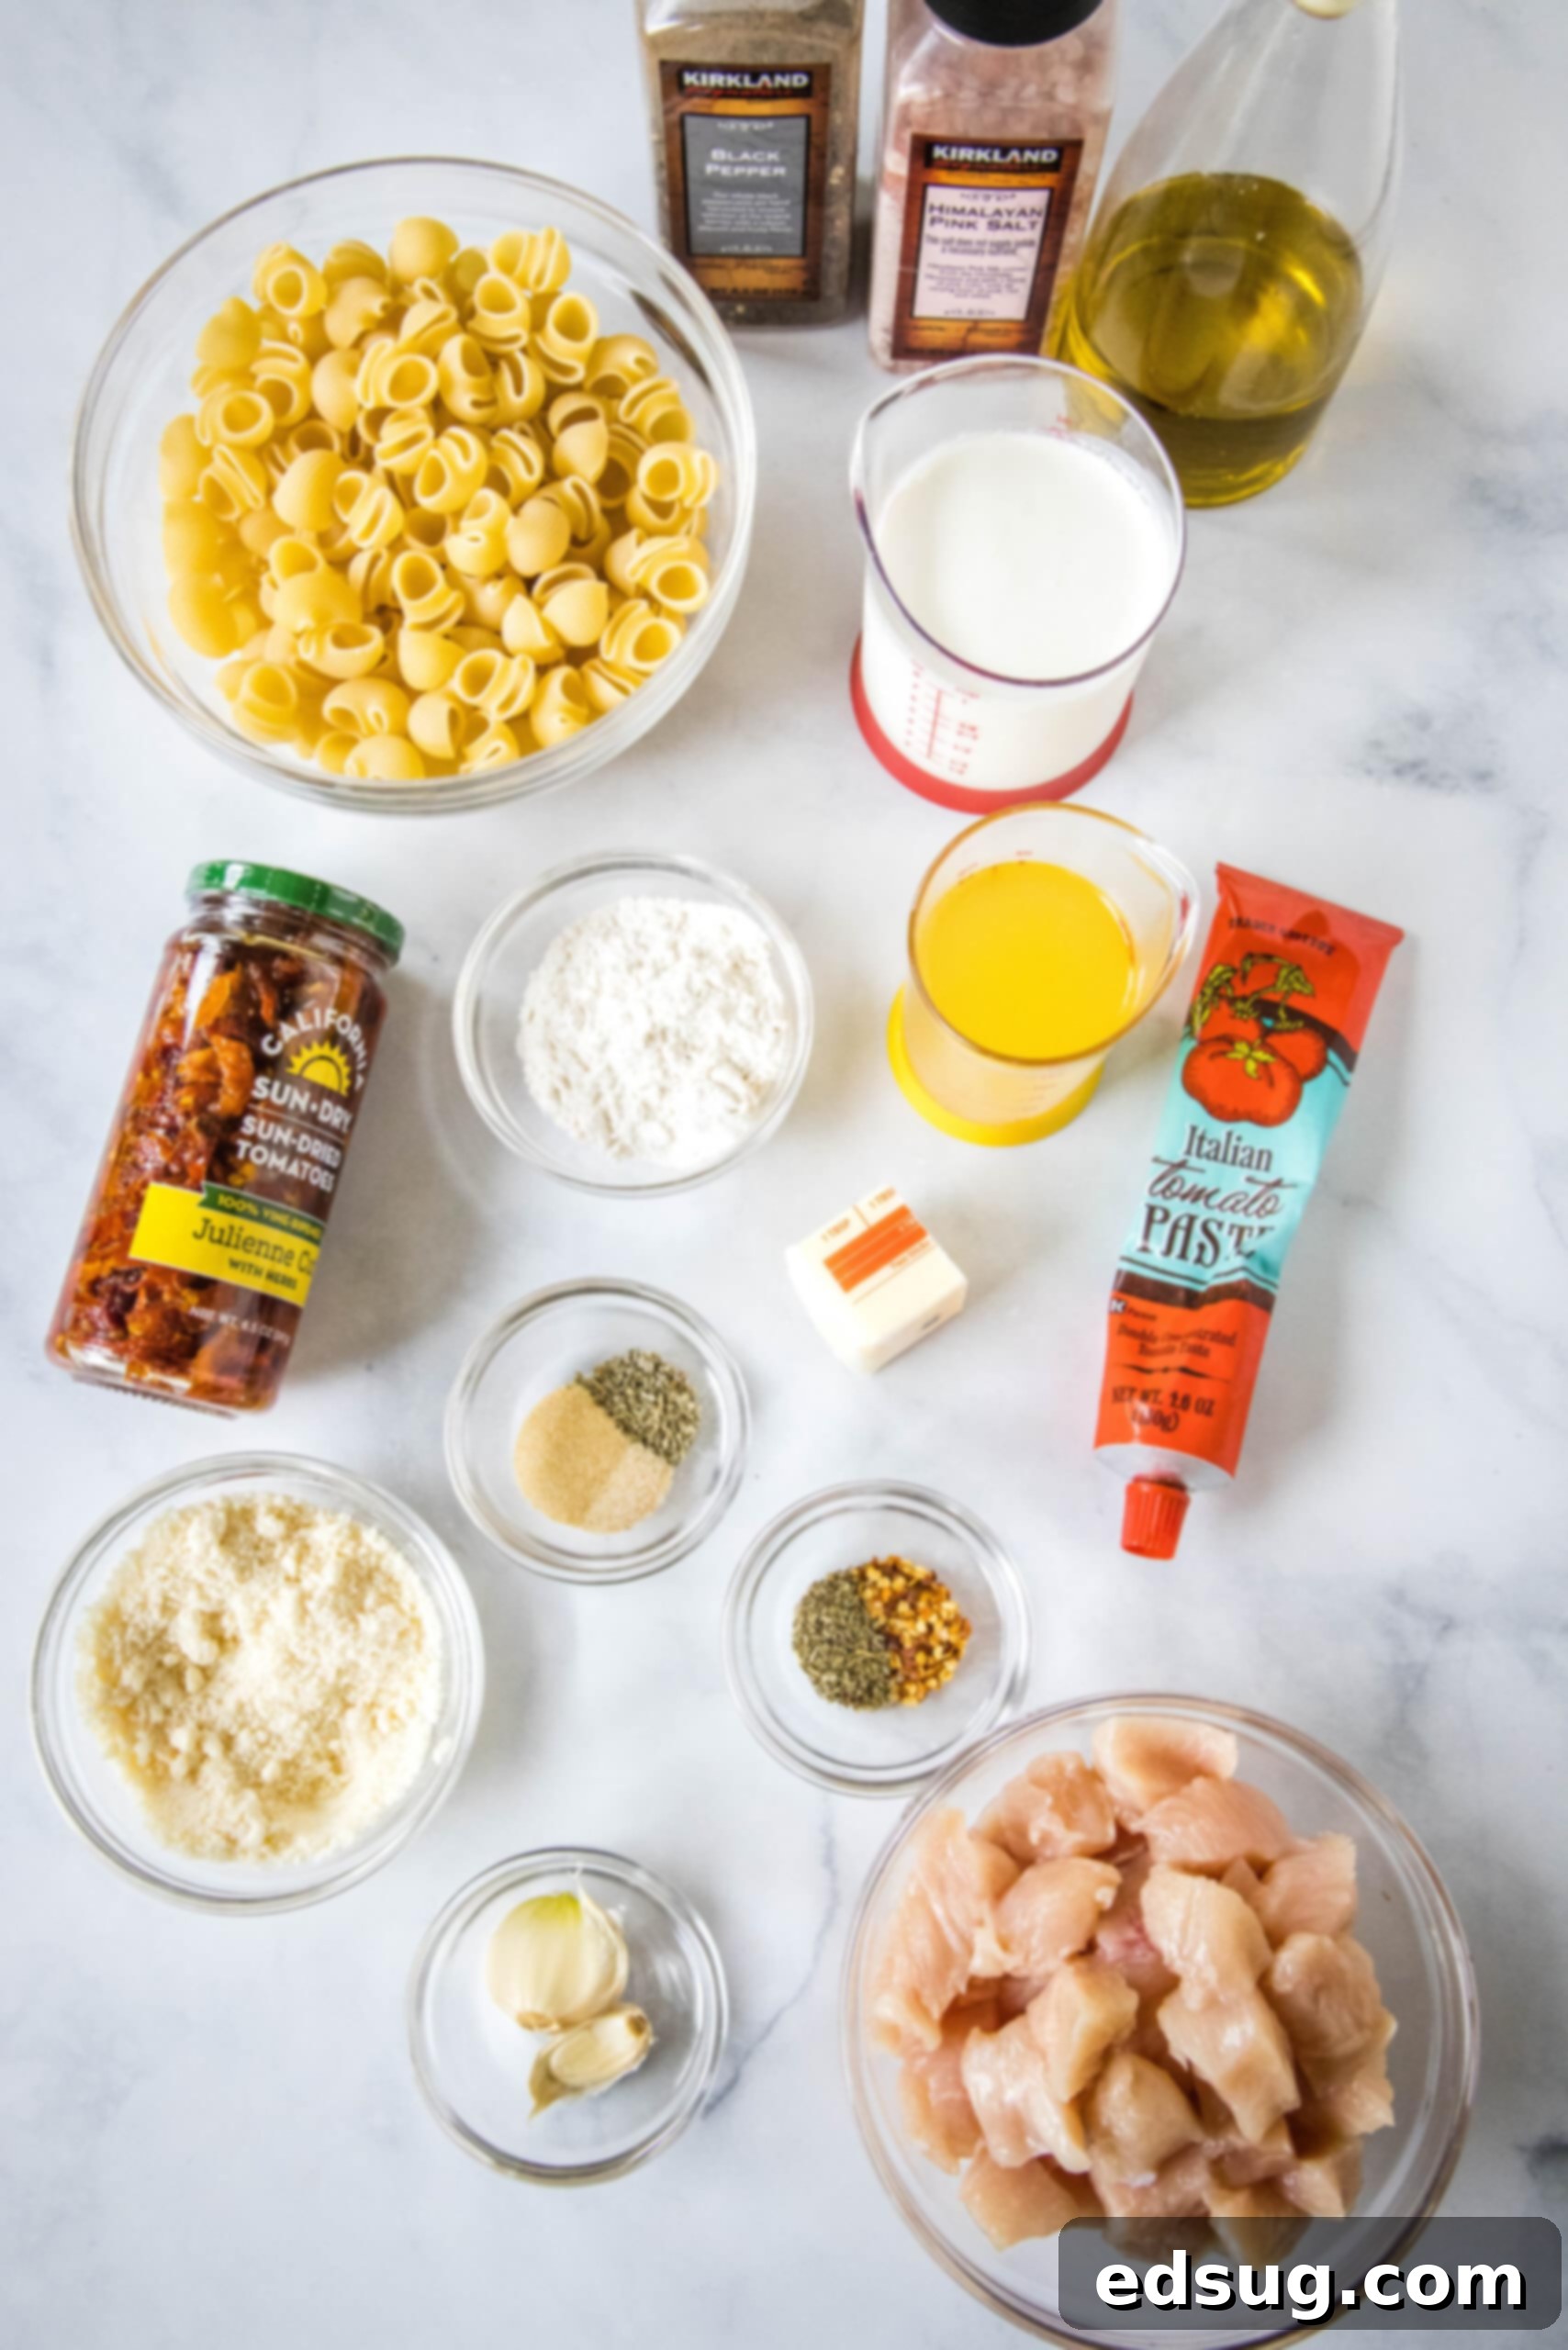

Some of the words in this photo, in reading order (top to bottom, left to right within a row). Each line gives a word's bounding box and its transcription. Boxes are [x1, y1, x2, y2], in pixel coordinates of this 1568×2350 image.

[683, 71, 810, 88] KIRKLAND
[711, 148, 779, 162] BLACK
[932, 144, 1059, 163] KIRKLAND
[705, 163, 787, 177] PEPPER
[927, 203, 1044, 218] HIMALAYAN
[929, 216, 978, 230] PINK
[987, 219, 1039, 231] SALT
[1183, 1125, 1273, 1173] Italian
[1148, 1155, 1299, 1220] tomato
[192, 1217, 296, 1267] Julienne
[228, 1259, 263, 1278] WITH
